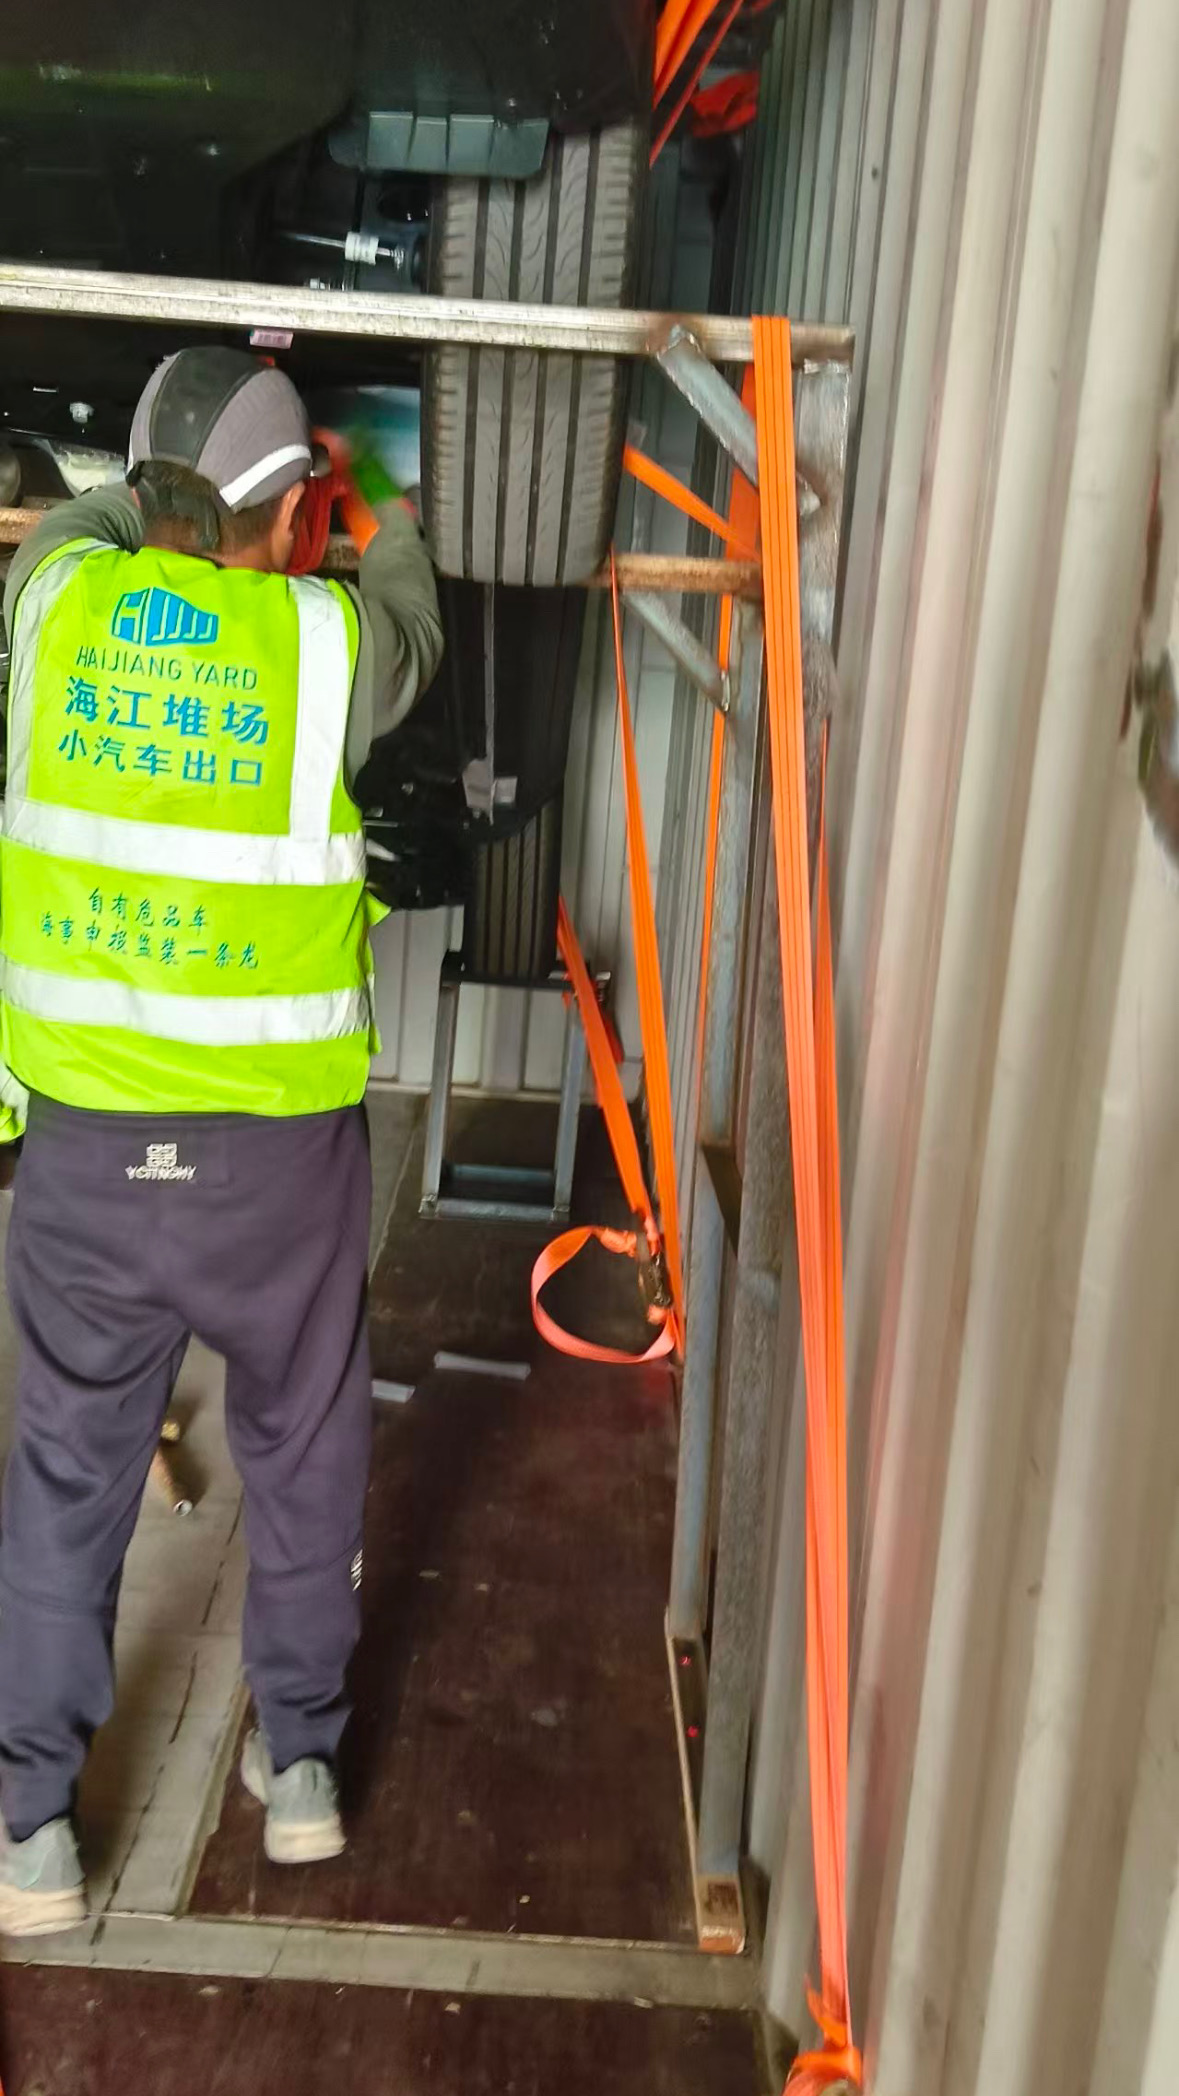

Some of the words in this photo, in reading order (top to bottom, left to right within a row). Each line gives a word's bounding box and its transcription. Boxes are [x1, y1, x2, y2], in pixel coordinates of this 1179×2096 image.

[76, 645, 182, 681] HAIJIANG
[192, 660, 258, 691] YARD
[65, 675, 269, 745] 海江堆场
[58, 729, 263, 786] 小汽车出口
[88, 887, 208, 936] 自有危品车
